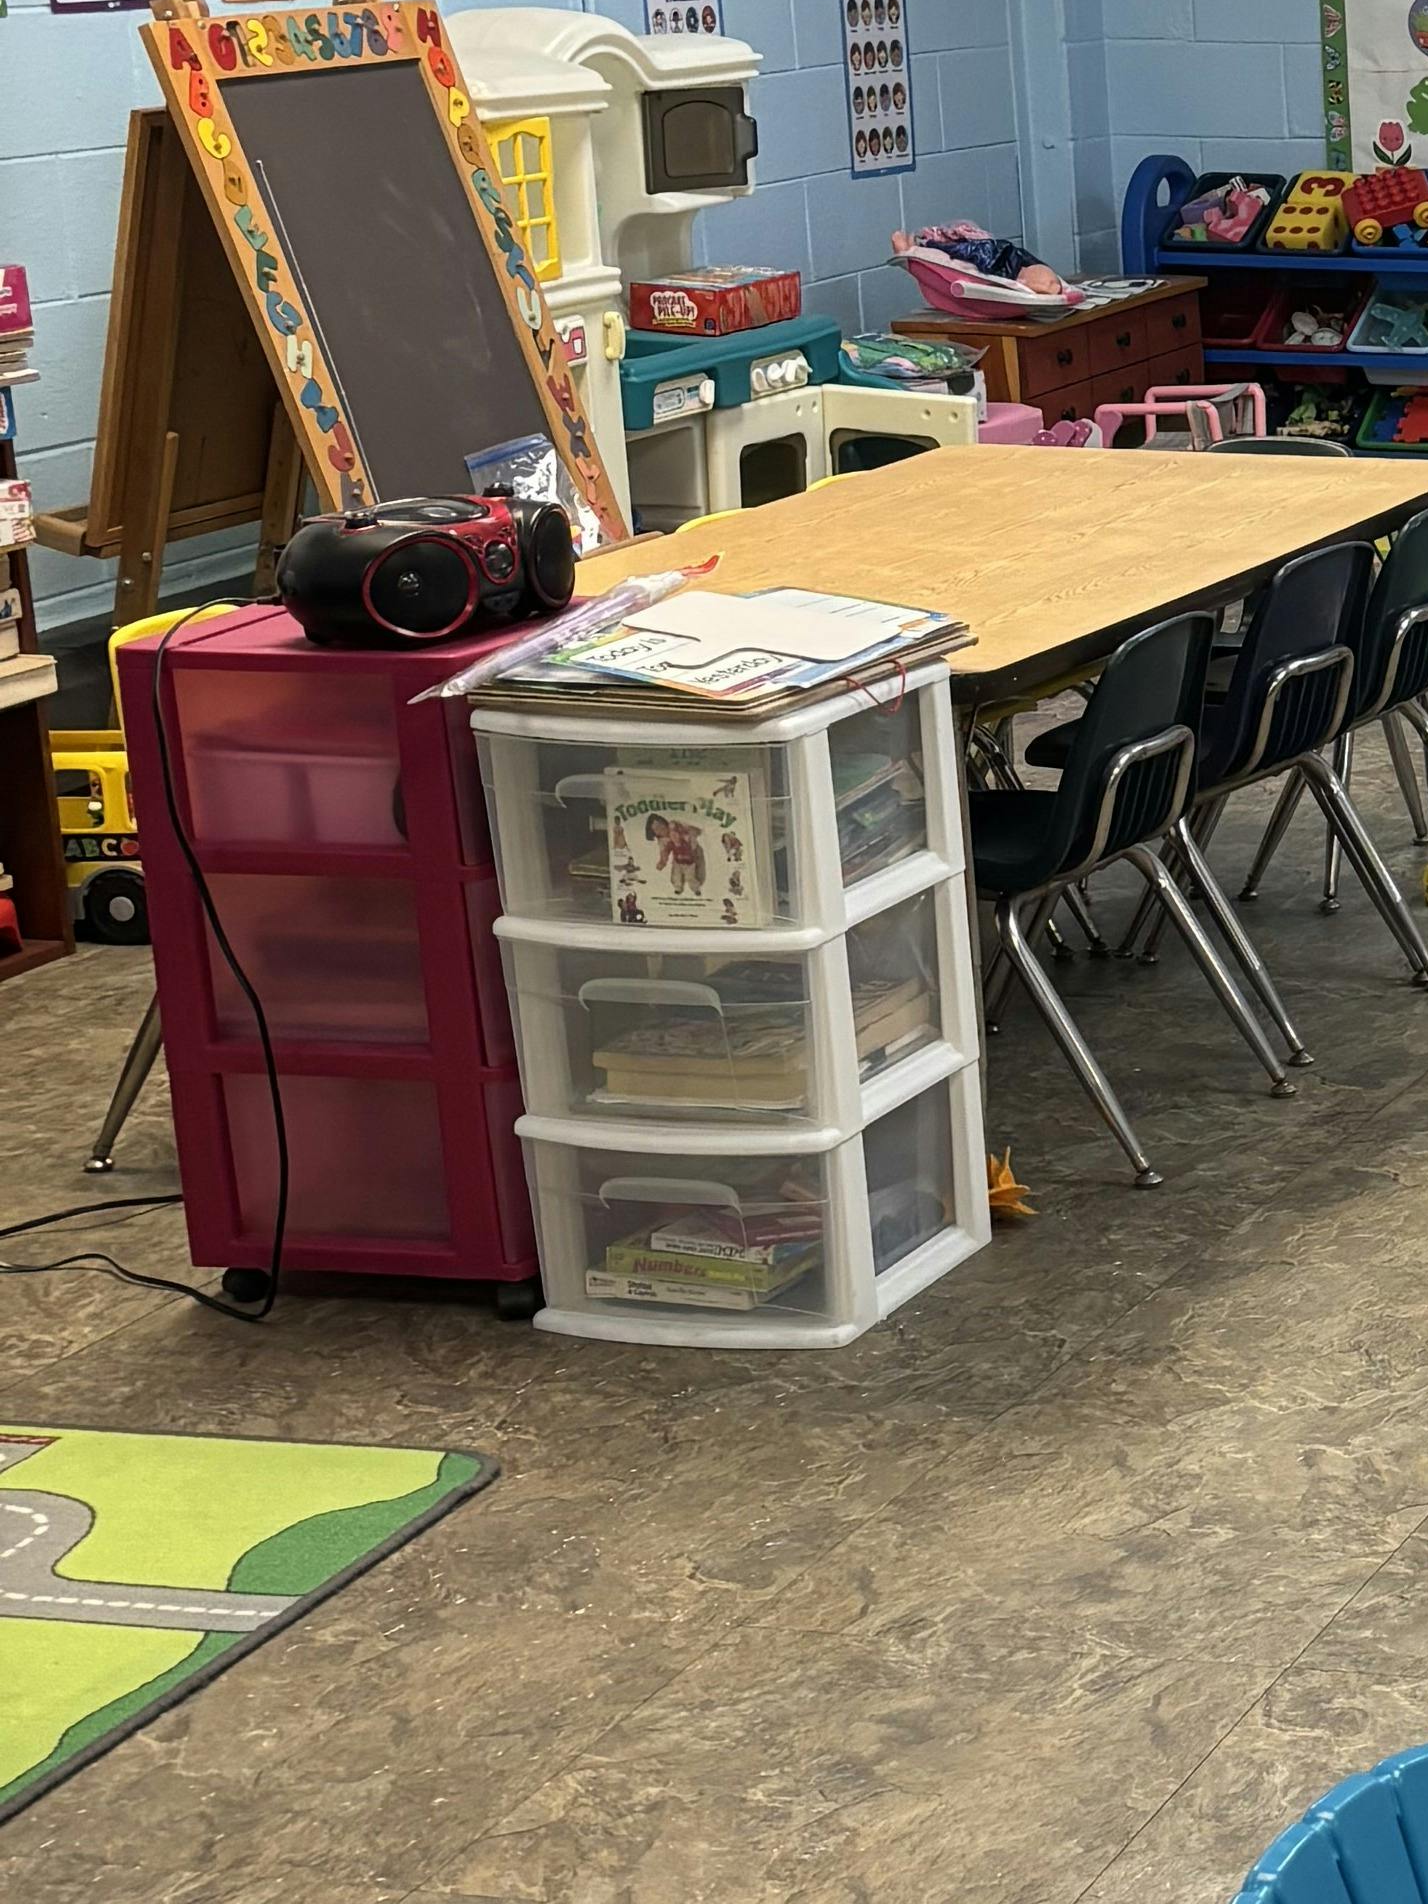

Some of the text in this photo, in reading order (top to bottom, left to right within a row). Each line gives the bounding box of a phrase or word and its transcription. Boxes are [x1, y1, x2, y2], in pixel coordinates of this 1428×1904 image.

[586, 636, 668, 664] Today is
[688, 654, 785, 686] Yesterday
[614, 797, 688, 823] Toddler
[66, 837, 118, 858] ABC
[633, 1257, 706, 1278] Numbers
